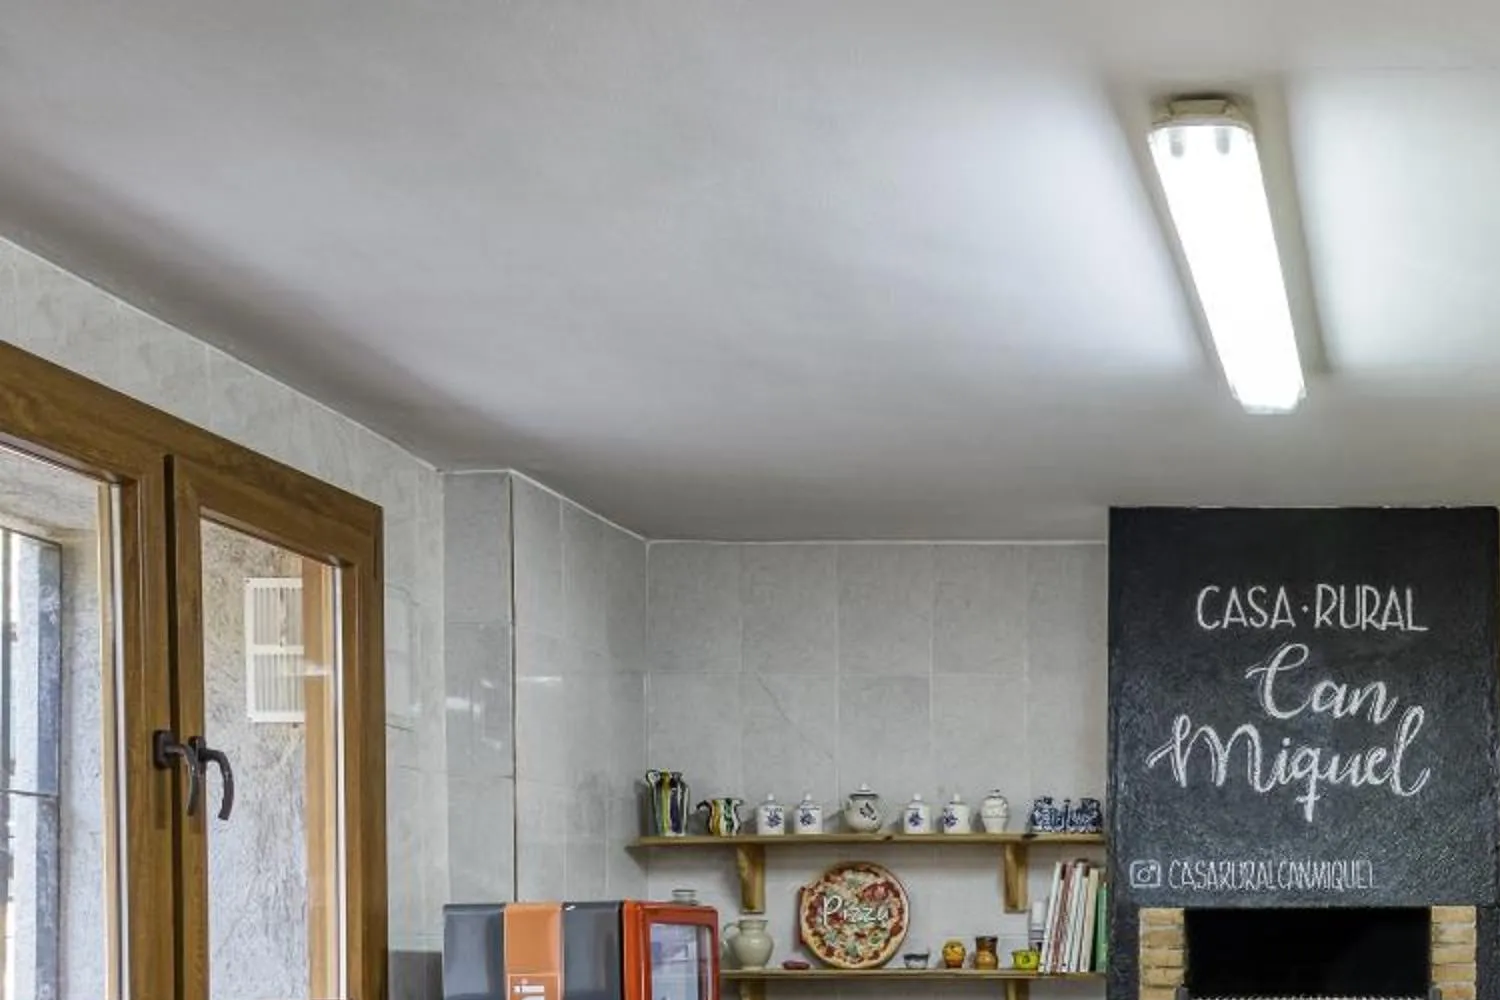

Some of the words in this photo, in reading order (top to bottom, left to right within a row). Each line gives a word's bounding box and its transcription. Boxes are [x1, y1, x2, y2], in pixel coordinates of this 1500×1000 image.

[1196, 585, 1296, 630] CASA
[1314, 583, 1429, 631] RURAL
[1245, 641, 1400, 725] Can
[1146, 705, 1431, 822] Miquel
